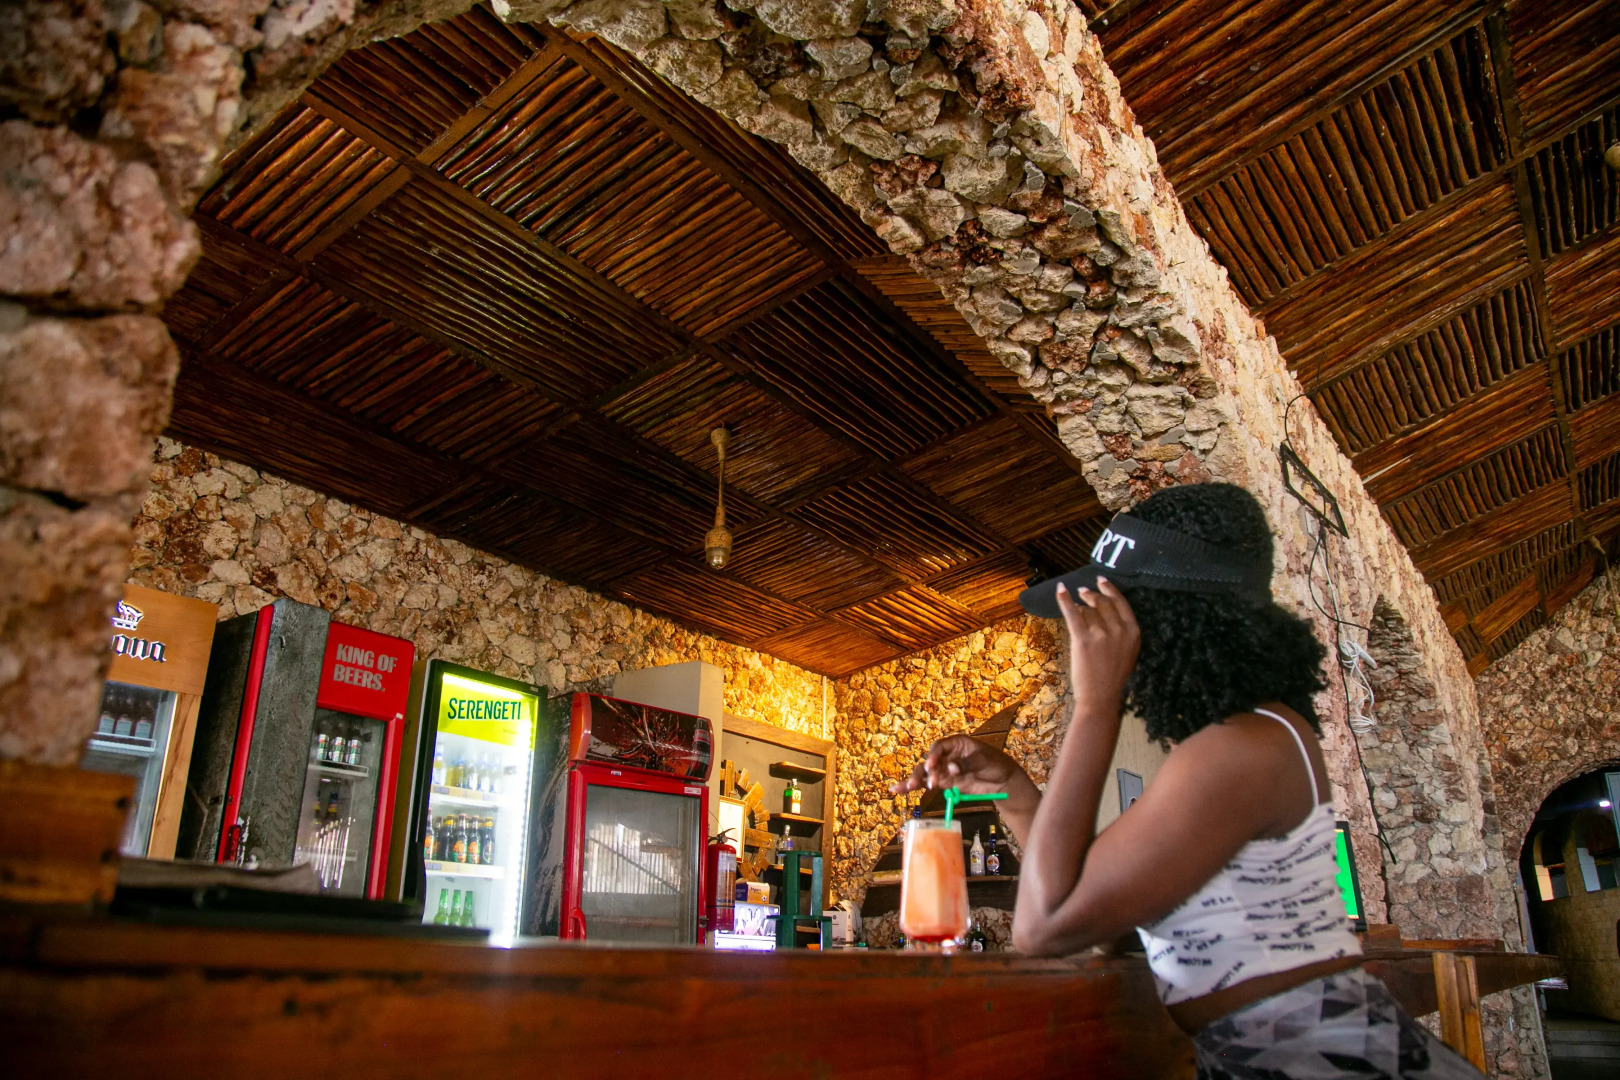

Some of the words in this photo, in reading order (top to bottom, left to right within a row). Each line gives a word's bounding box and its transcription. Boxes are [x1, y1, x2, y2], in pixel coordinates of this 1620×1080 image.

[1091, 528, 1136, 569] RT
[110, 633, 167, 663] ona
[336, 643, 375, 669] KING
[377, 654, 398, 673] OF
[333, 663, 386, 692] BEERS.
[447, 697, 522, 720] SERENGETI
